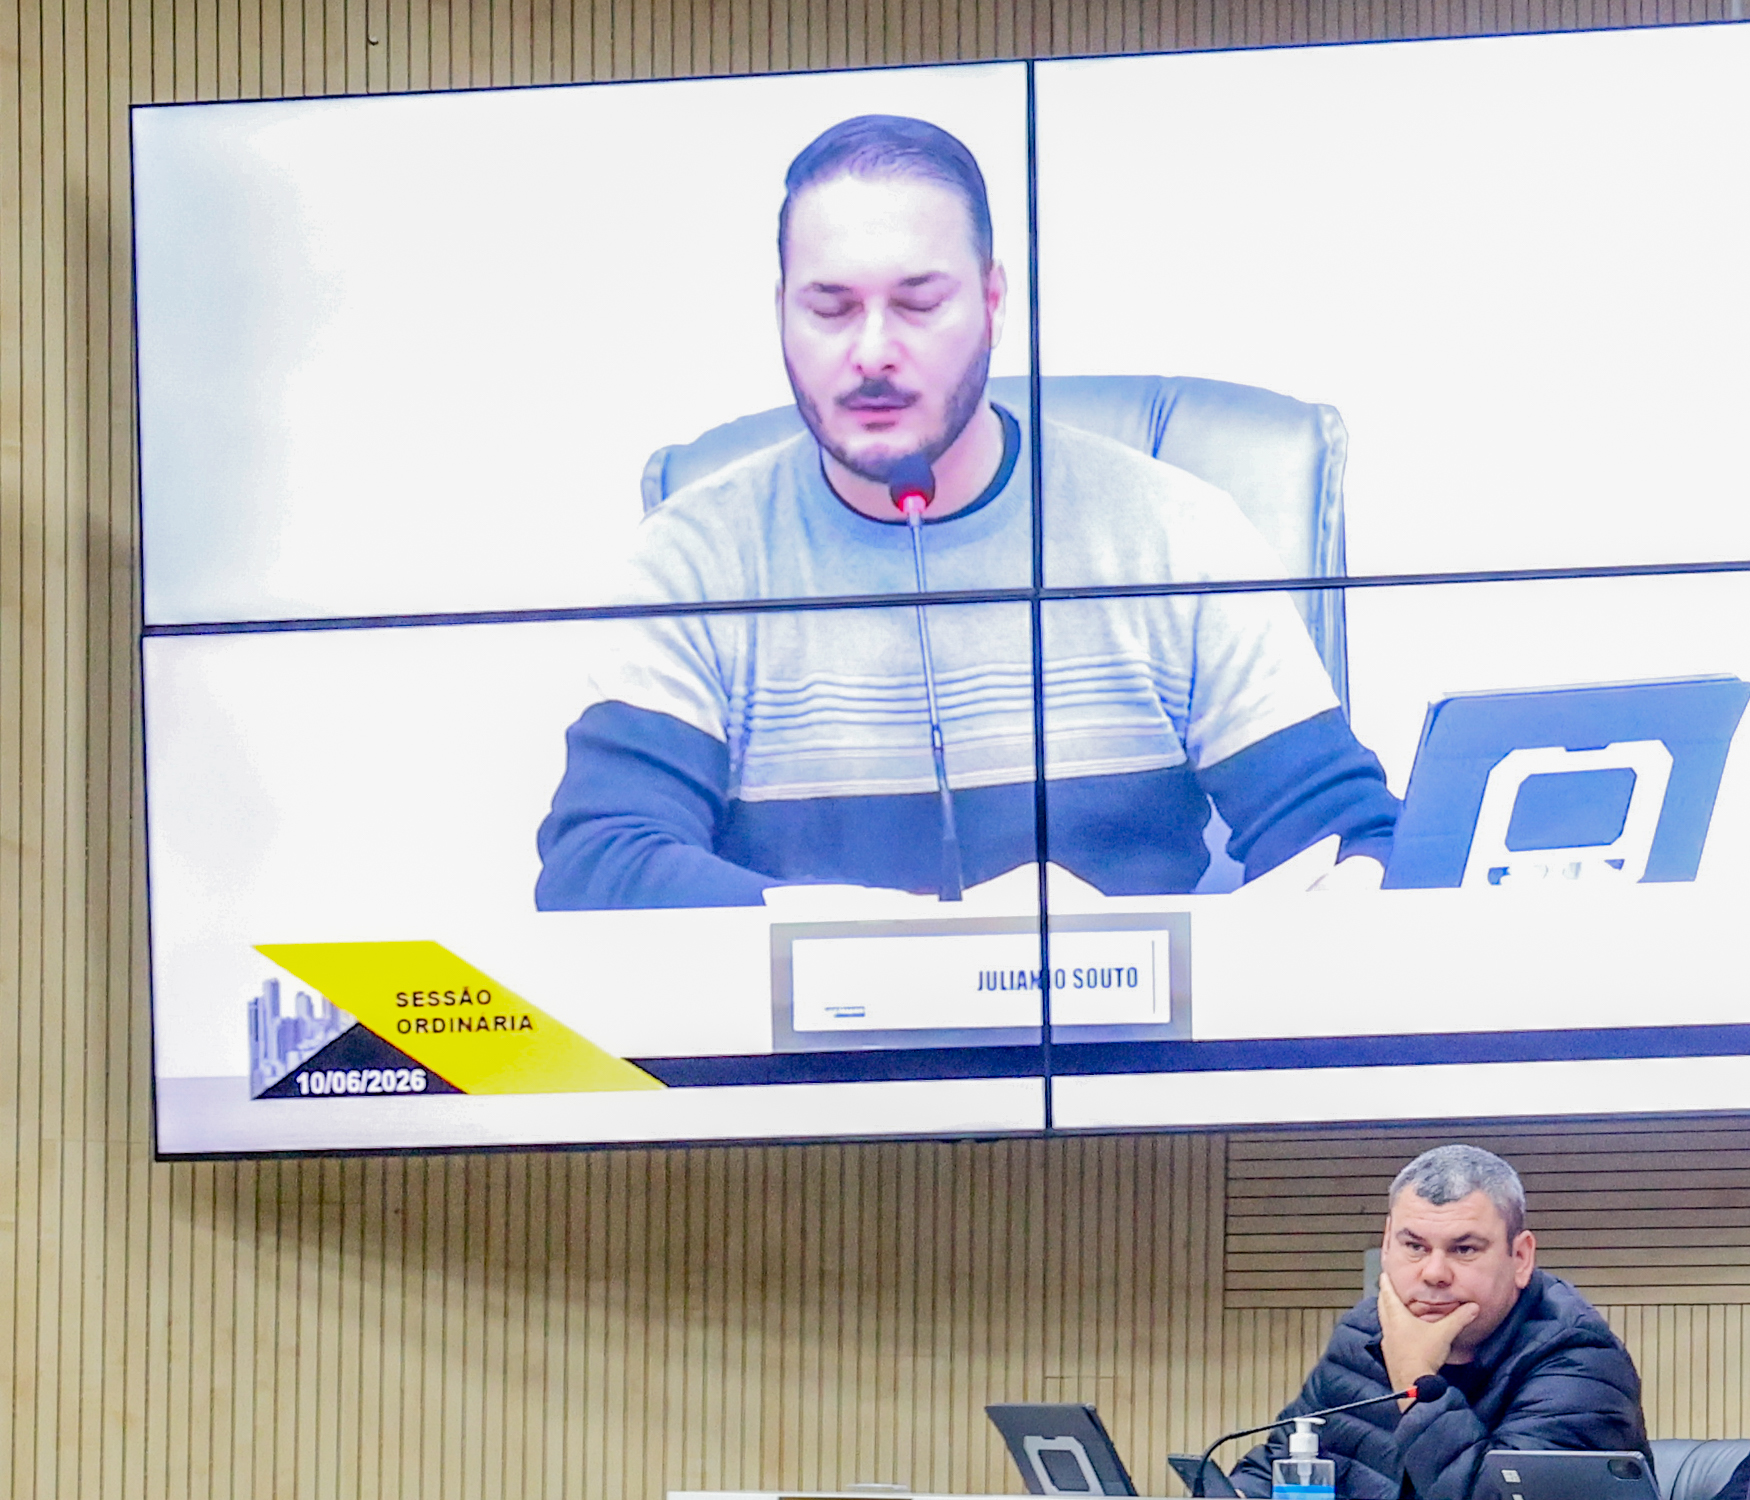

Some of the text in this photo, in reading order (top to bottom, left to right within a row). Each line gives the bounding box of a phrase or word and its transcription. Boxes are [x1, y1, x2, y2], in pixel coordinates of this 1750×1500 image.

[1073, 967, 1138, 989] SOUTO
[396, 986, 492, 1008] SESSÃO
[397, 1013, 534, 1034] ORDINÁRIA
[297, 1068, 426, 1094] 10/06/2026
